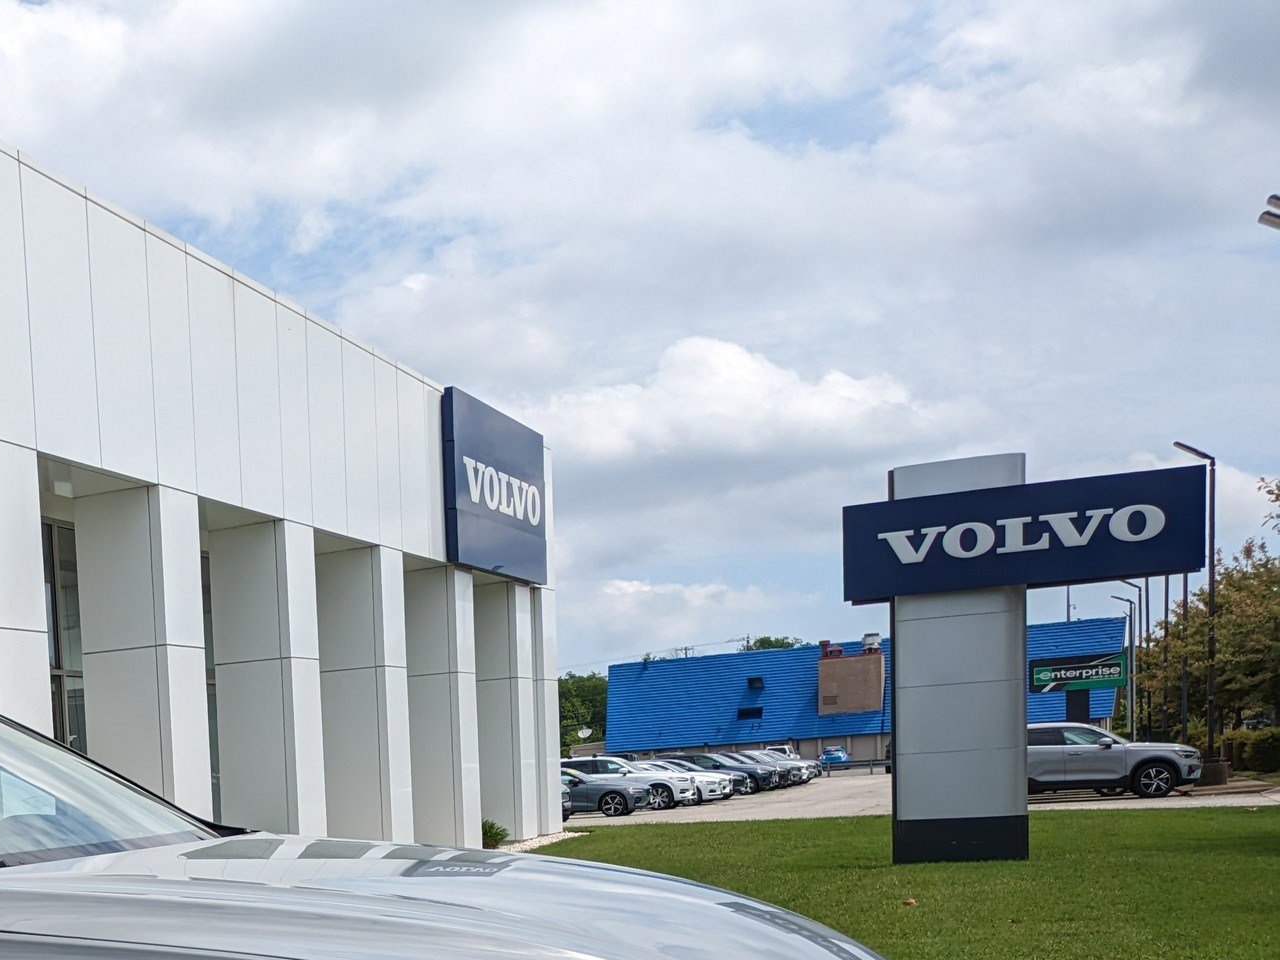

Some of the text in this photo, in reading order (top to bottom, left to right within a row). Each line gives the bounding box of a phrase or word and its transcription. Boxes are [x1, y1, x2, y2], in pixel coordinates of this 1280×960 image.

[463, 455, 541, 526] VOLVO
[877, 504, 1166, 565] VOLVO
[1039, 665, 1121, 680] enterprise
